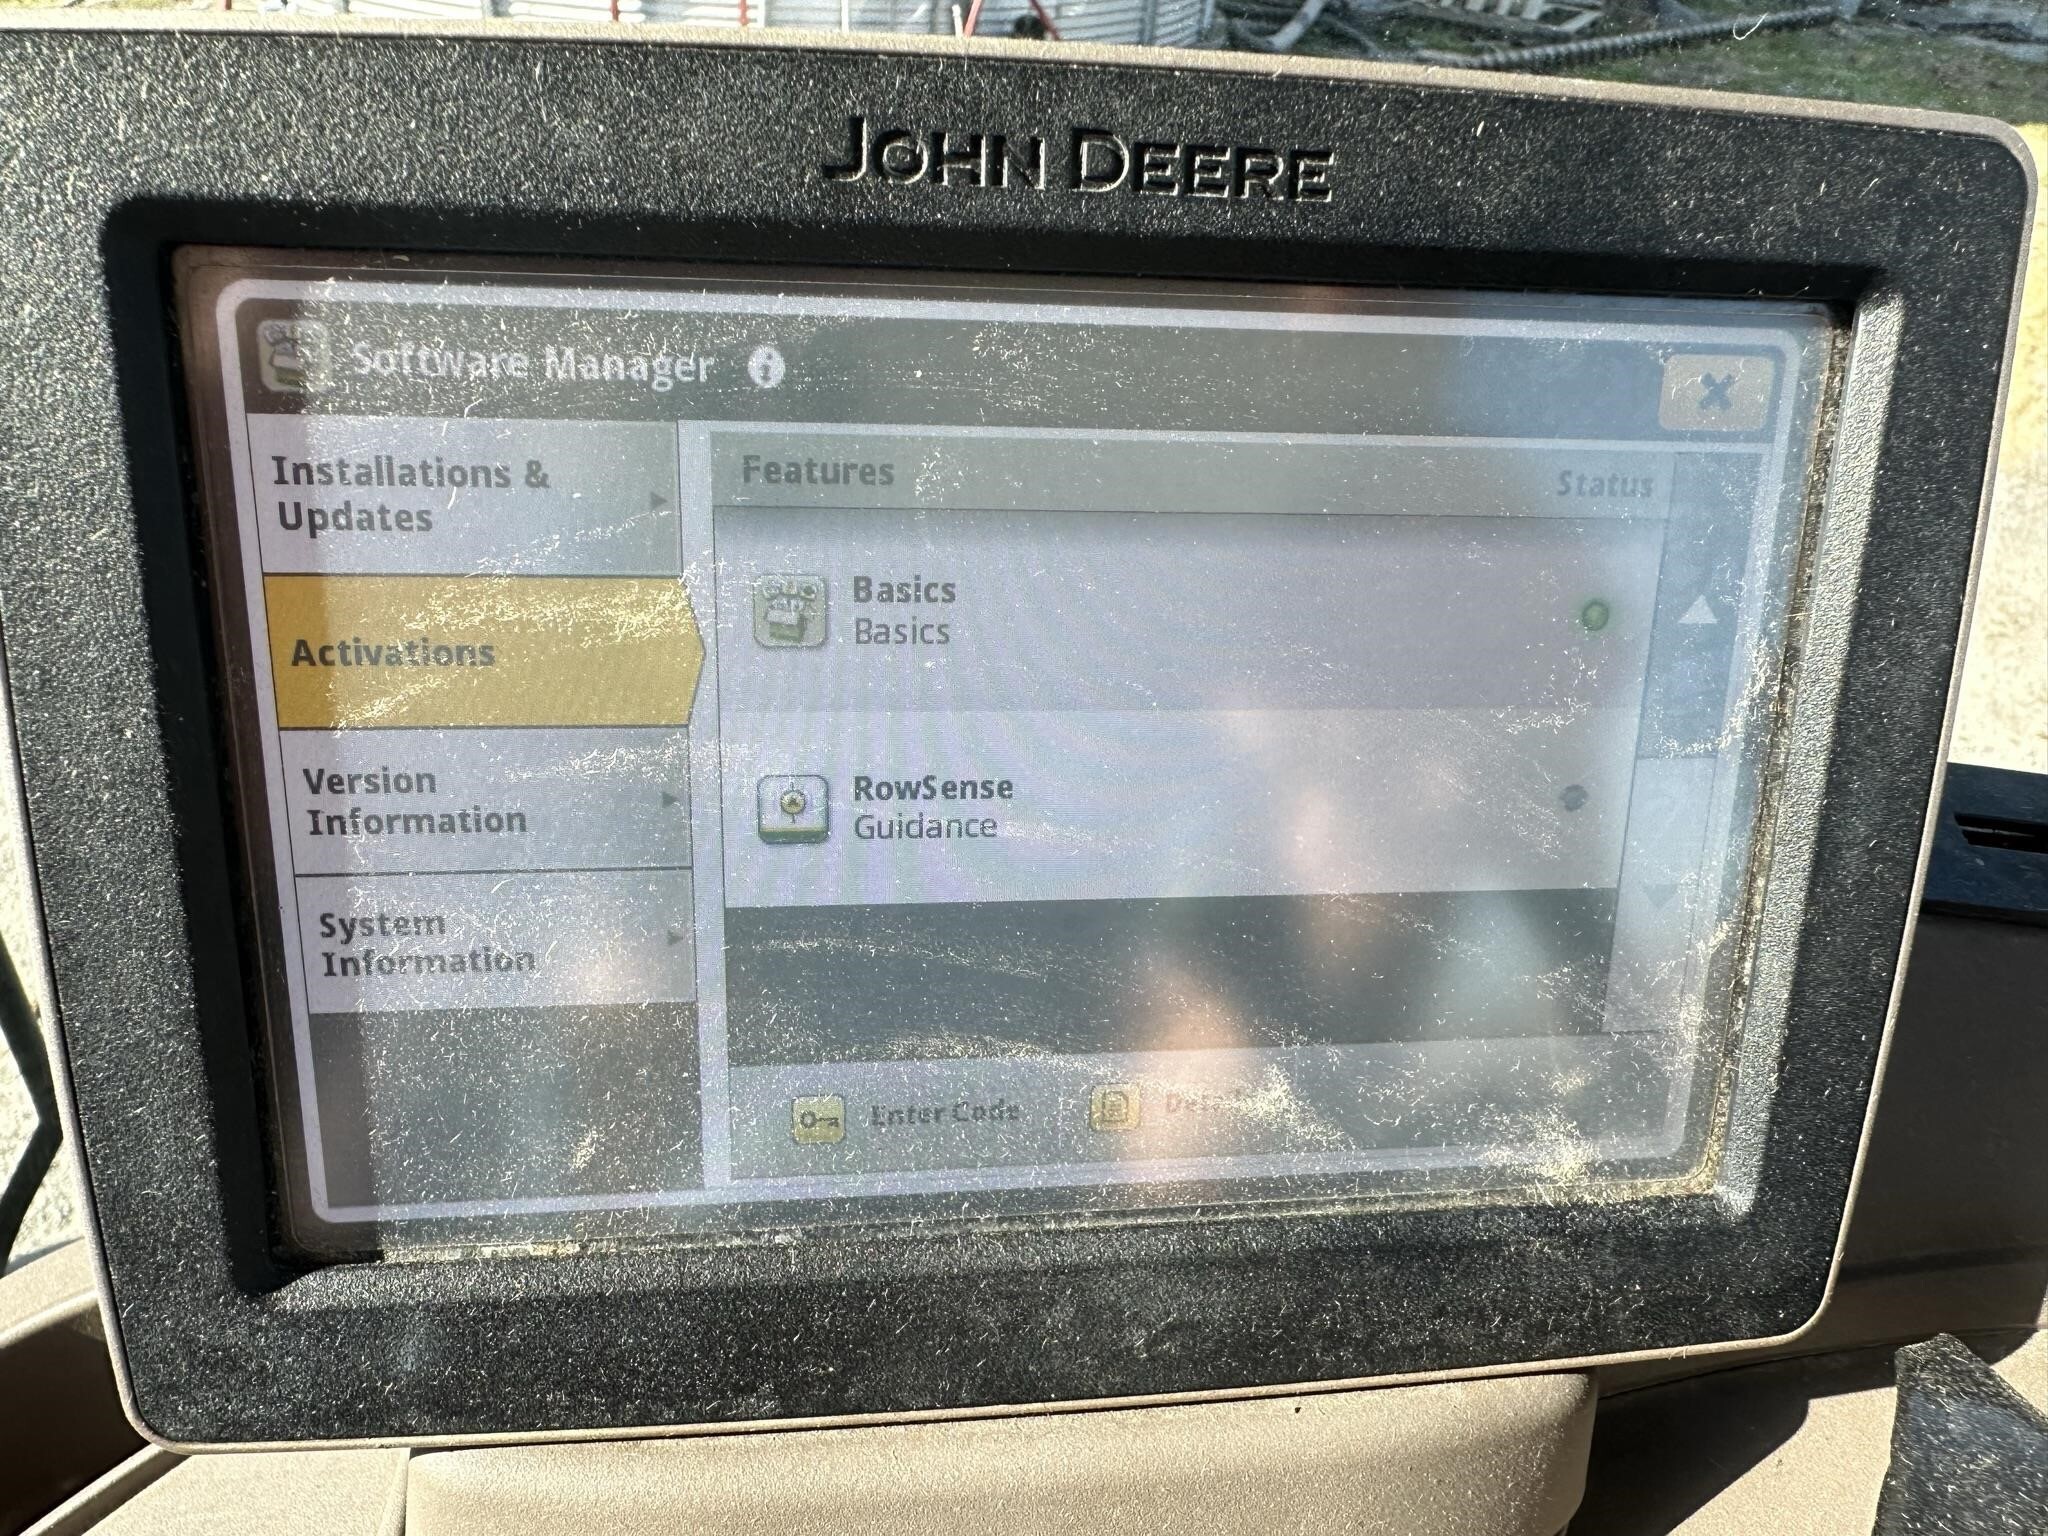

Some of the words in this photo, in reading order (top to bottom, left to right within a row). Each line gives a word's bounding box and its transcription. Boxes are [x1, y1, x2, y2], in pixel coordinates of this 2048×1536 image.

[823, 116, 1045, 191] JOHN
[1071, 127, 1334, 202] DEERE
[352, 341, 528, 381] Software
[545, 344, 713, 392] Manager
[273, 455, 512, 489] Installations
[525, 460, 550, 488] &
[742, 454, 894, 486] Features
[1557, 469, 1654, 498] Status
[278, 500, 434, 539] Updates
[853, 575, 957, 604] Basics
[855, 616, 951, 645] Basics
[291, 637, 496, 667] Activations
[303, 766, 437, 795] Version
[854, 775, 1014, 801] RowSense
[307, 806, 527, 837] Information
[855, 812, 998, 840] Guidance
[320, 912, 446, 945] System
[322, 946, 536, 977] Information
[871, 1103, 944, 1128] Enter
[952, 1099, 1020, 1124] Code
